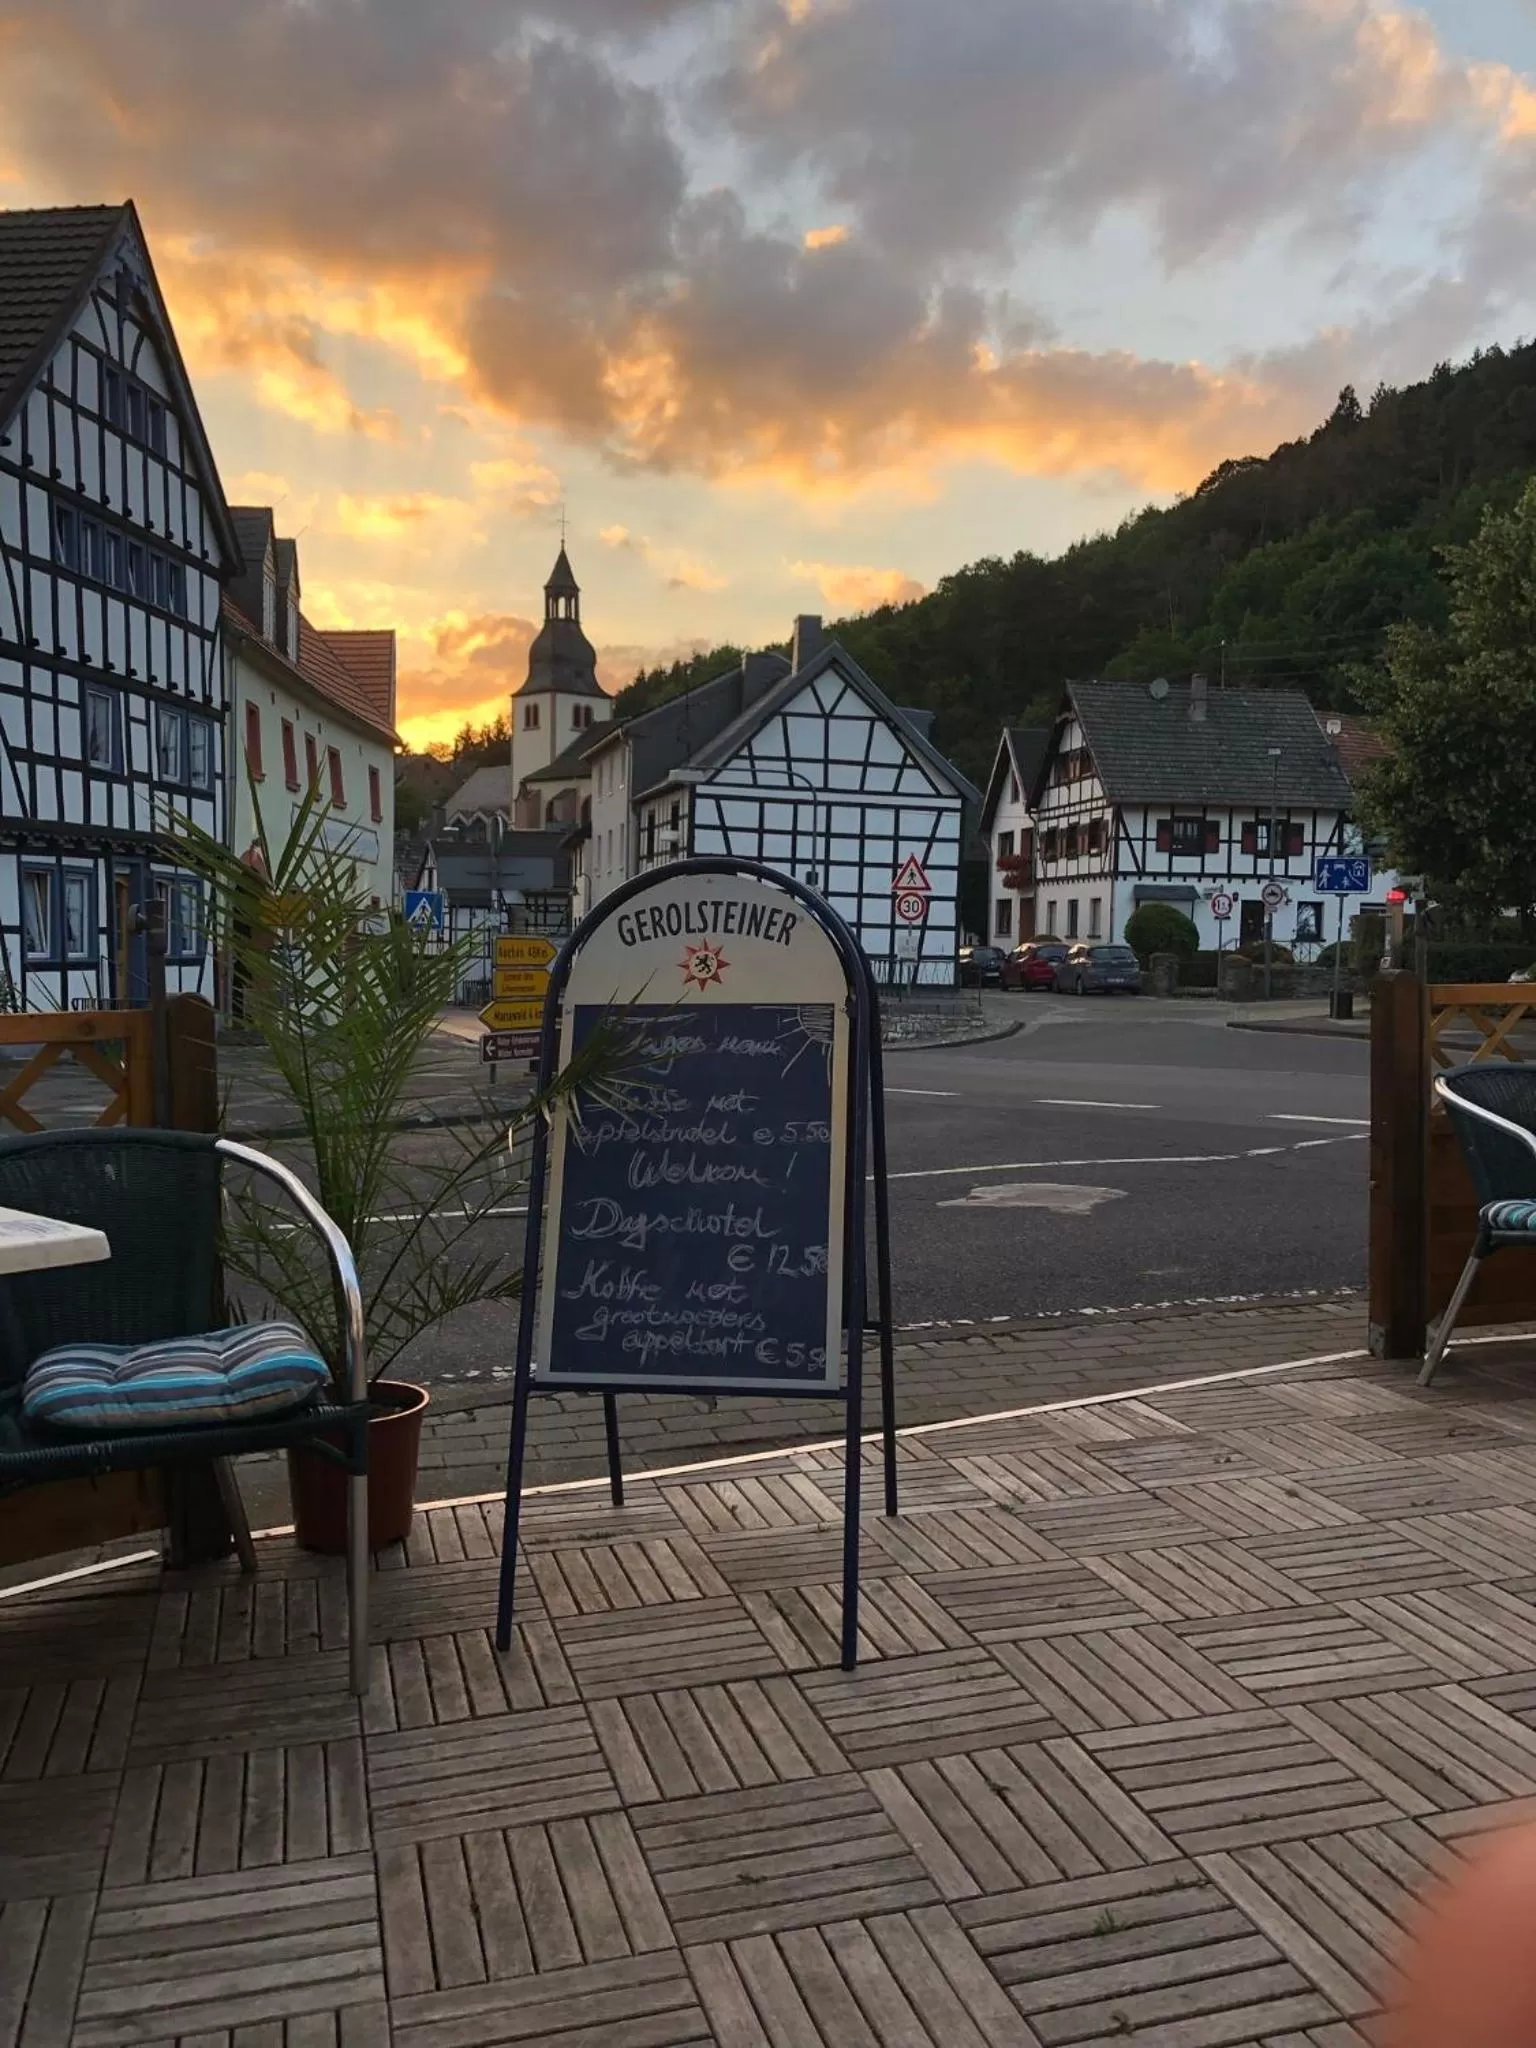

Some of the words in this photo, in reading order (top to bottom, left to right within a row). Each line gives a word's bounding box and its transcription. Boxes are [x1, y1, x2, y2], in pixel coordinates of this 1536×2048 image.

[904, 900, 920, 913] 30
[617, 901, 797, 946] GEROLSTEINER
[727, 1244, 755, 1272] €
